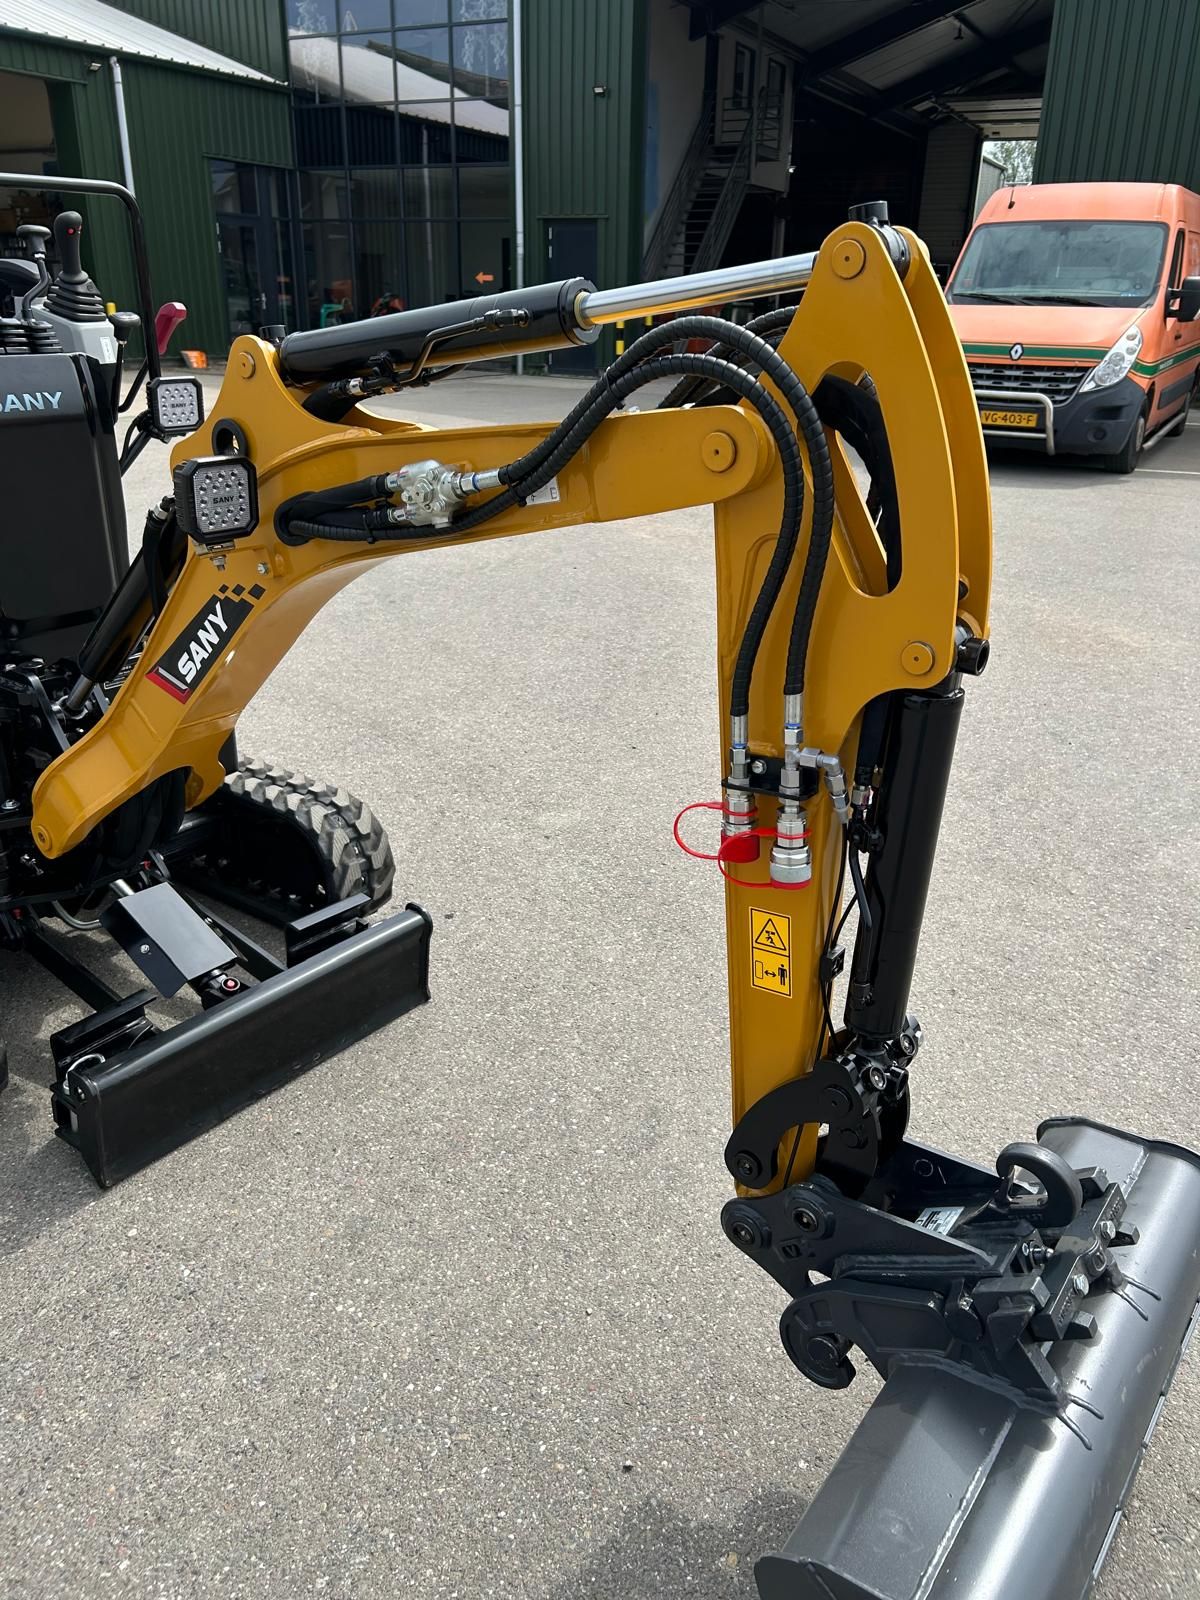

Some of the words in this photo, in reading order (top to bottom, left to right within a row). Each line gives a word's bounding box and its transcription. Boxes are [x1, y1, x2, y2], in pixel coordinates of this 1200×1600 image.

[0, 391, 62, 413] ANY
[984, 412, 1034, 425] VG-403-F
[212, 495, 235, 504] SANY
[177, 600, 228, 684] SANY
